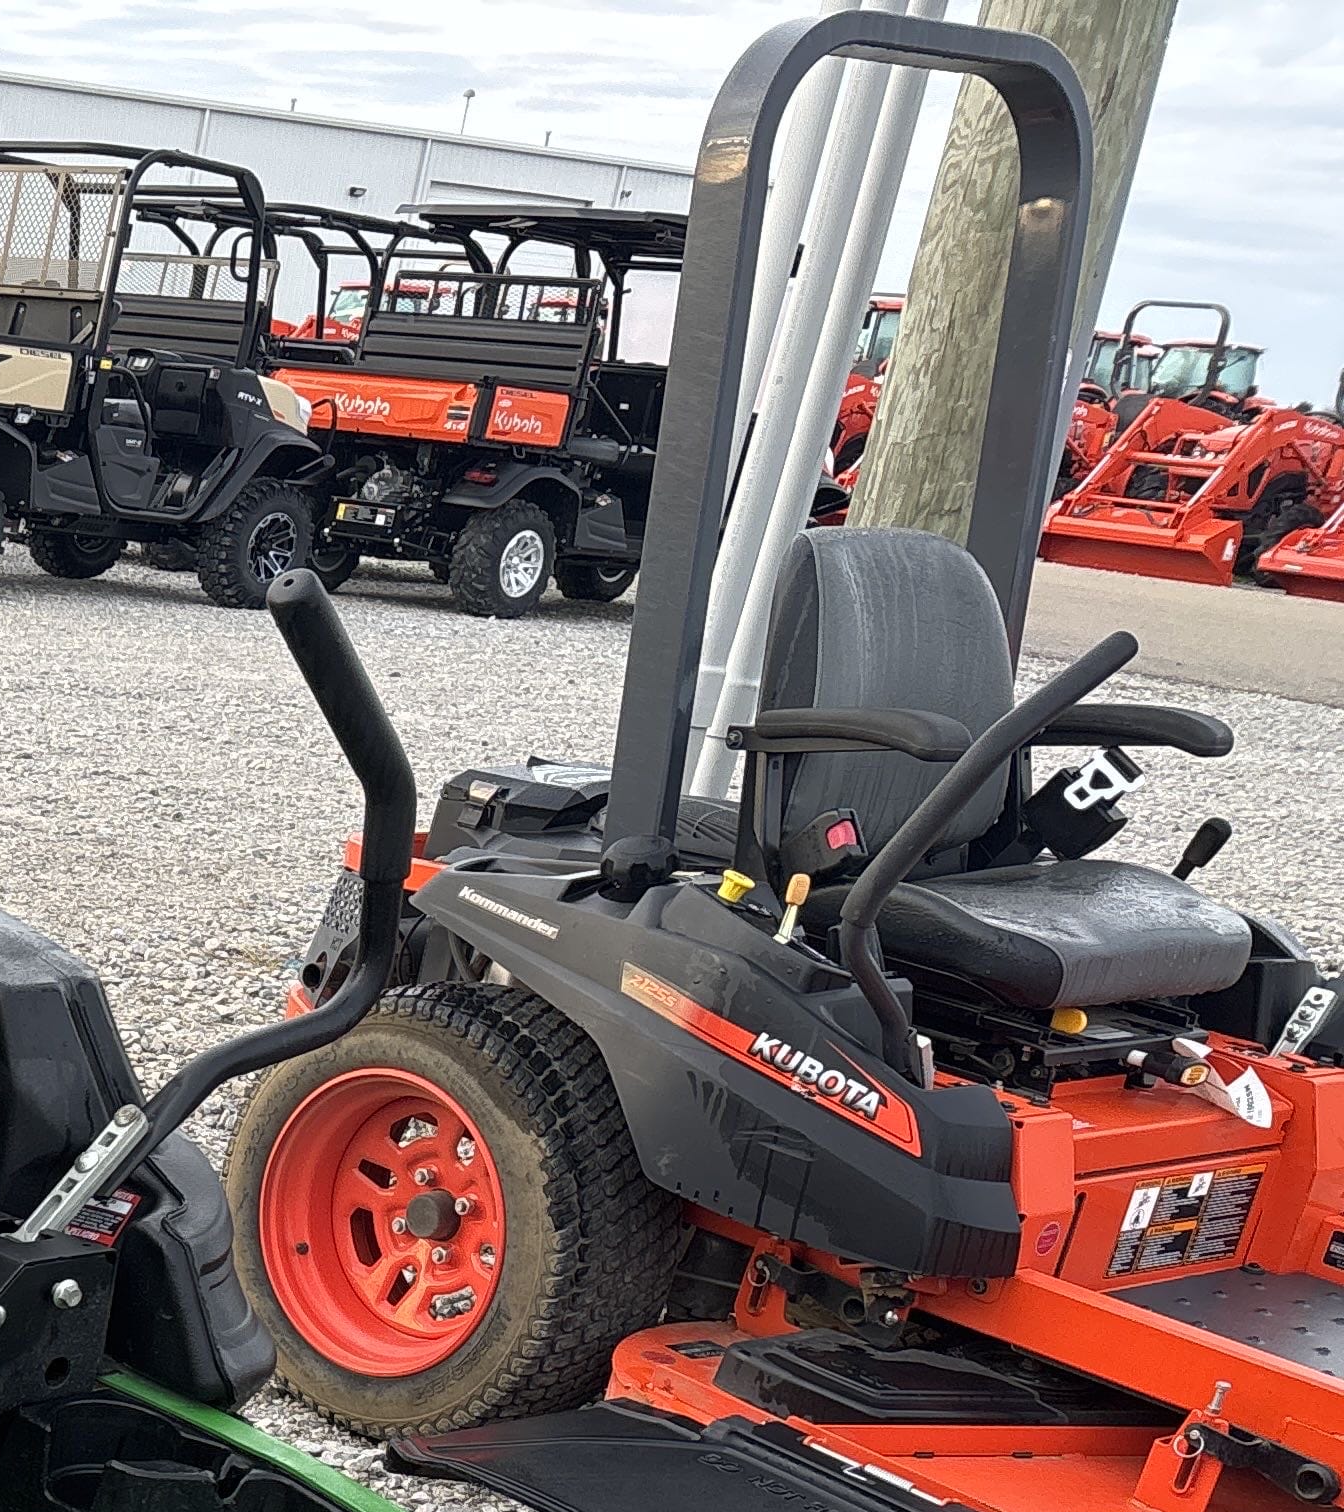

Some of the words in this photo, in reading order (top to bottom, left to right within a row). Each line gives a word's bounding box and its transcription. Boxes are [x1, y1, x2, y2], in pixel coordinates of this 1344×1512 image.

[237, 391, 263, 407] RTV-X
[335, 393, 391, 417] Kubota
[494, 410, 543, 435] Kubota
[457, 886, 561, 940] Kommander
[750, 1032, 889, 1121] KUBOTA
[697, 1453, 745, 1474] DO
[746, 1475, 807, 1502] NOT
